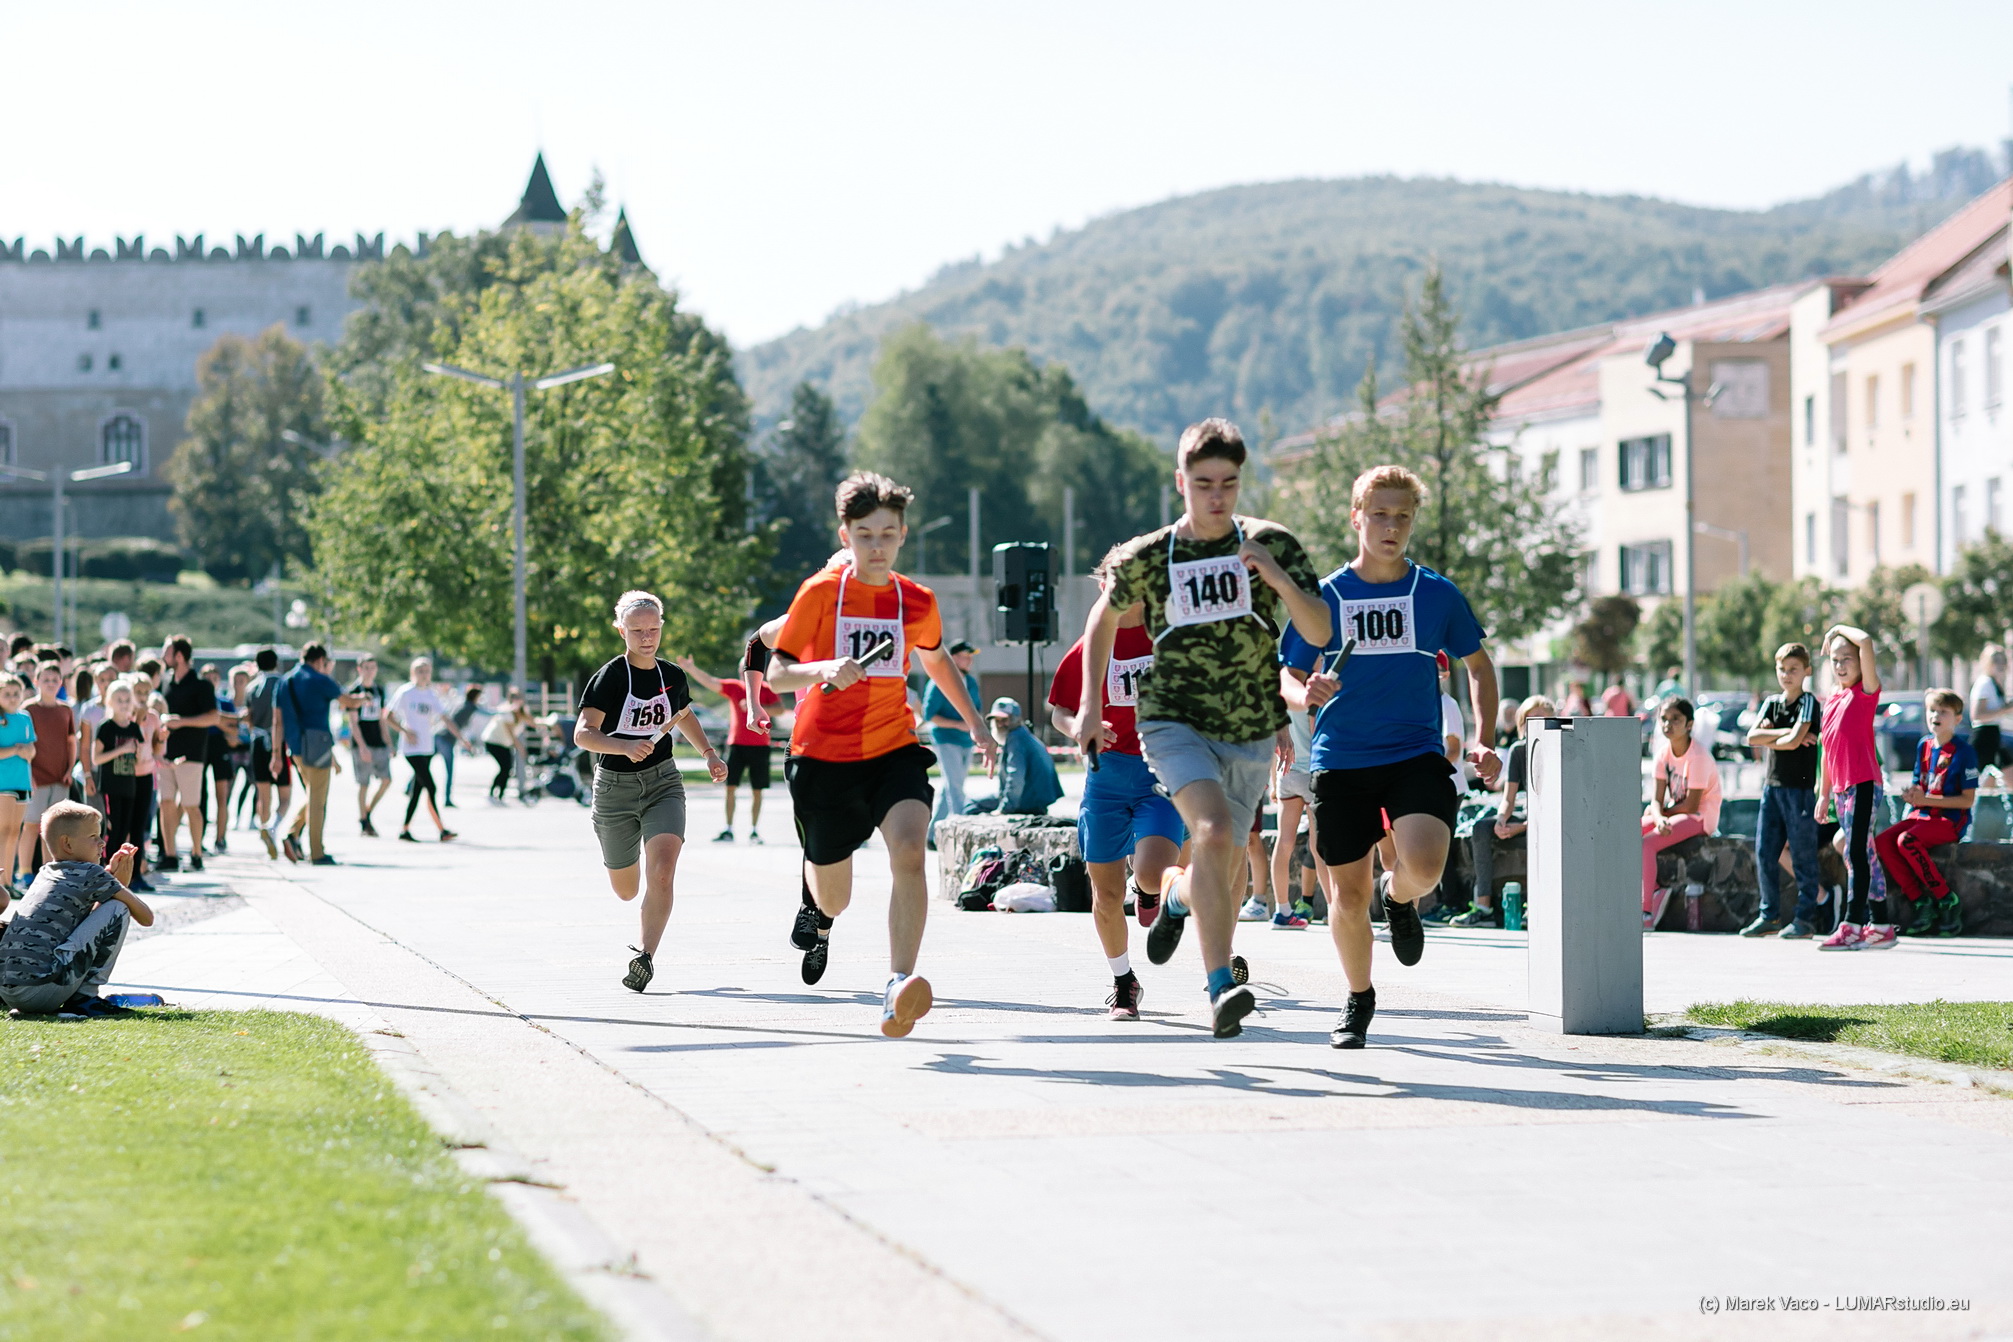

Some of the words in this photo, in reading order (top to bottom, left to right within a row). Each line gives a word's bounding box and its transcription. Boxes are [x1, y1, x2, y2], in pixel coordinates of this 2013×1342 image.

[1184, 571, 1238, 608] 140
[1352, 608, 1404, 642] 100
[631, 703, 666, 727] 158
